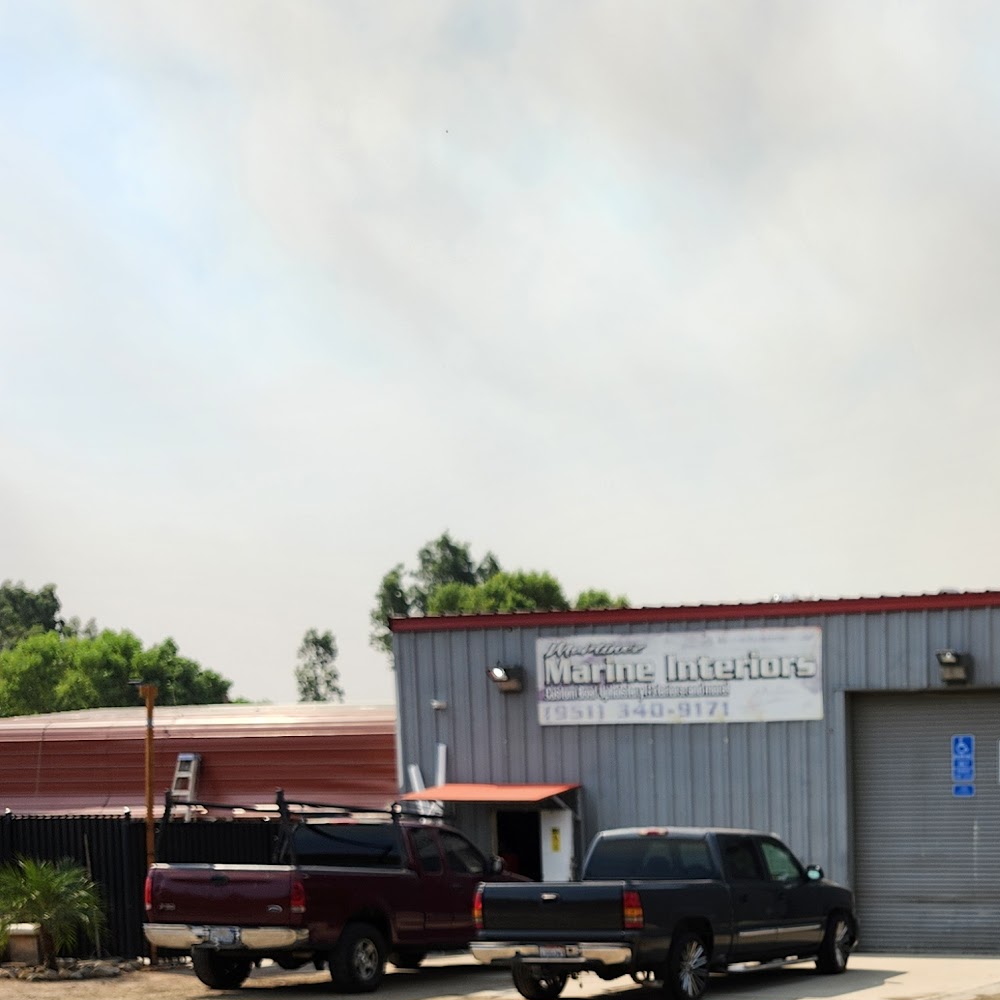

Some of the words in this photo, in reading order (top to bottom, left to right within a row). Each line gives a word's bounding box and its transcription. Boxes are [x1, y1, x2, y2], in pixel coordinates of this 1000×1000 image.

[543, 656, 656, 686] Marine
[665, 651, 818, 682] Interiors
[544, 685, 577, 700] Custom
[619, 701, 730, 719] 340-9171
